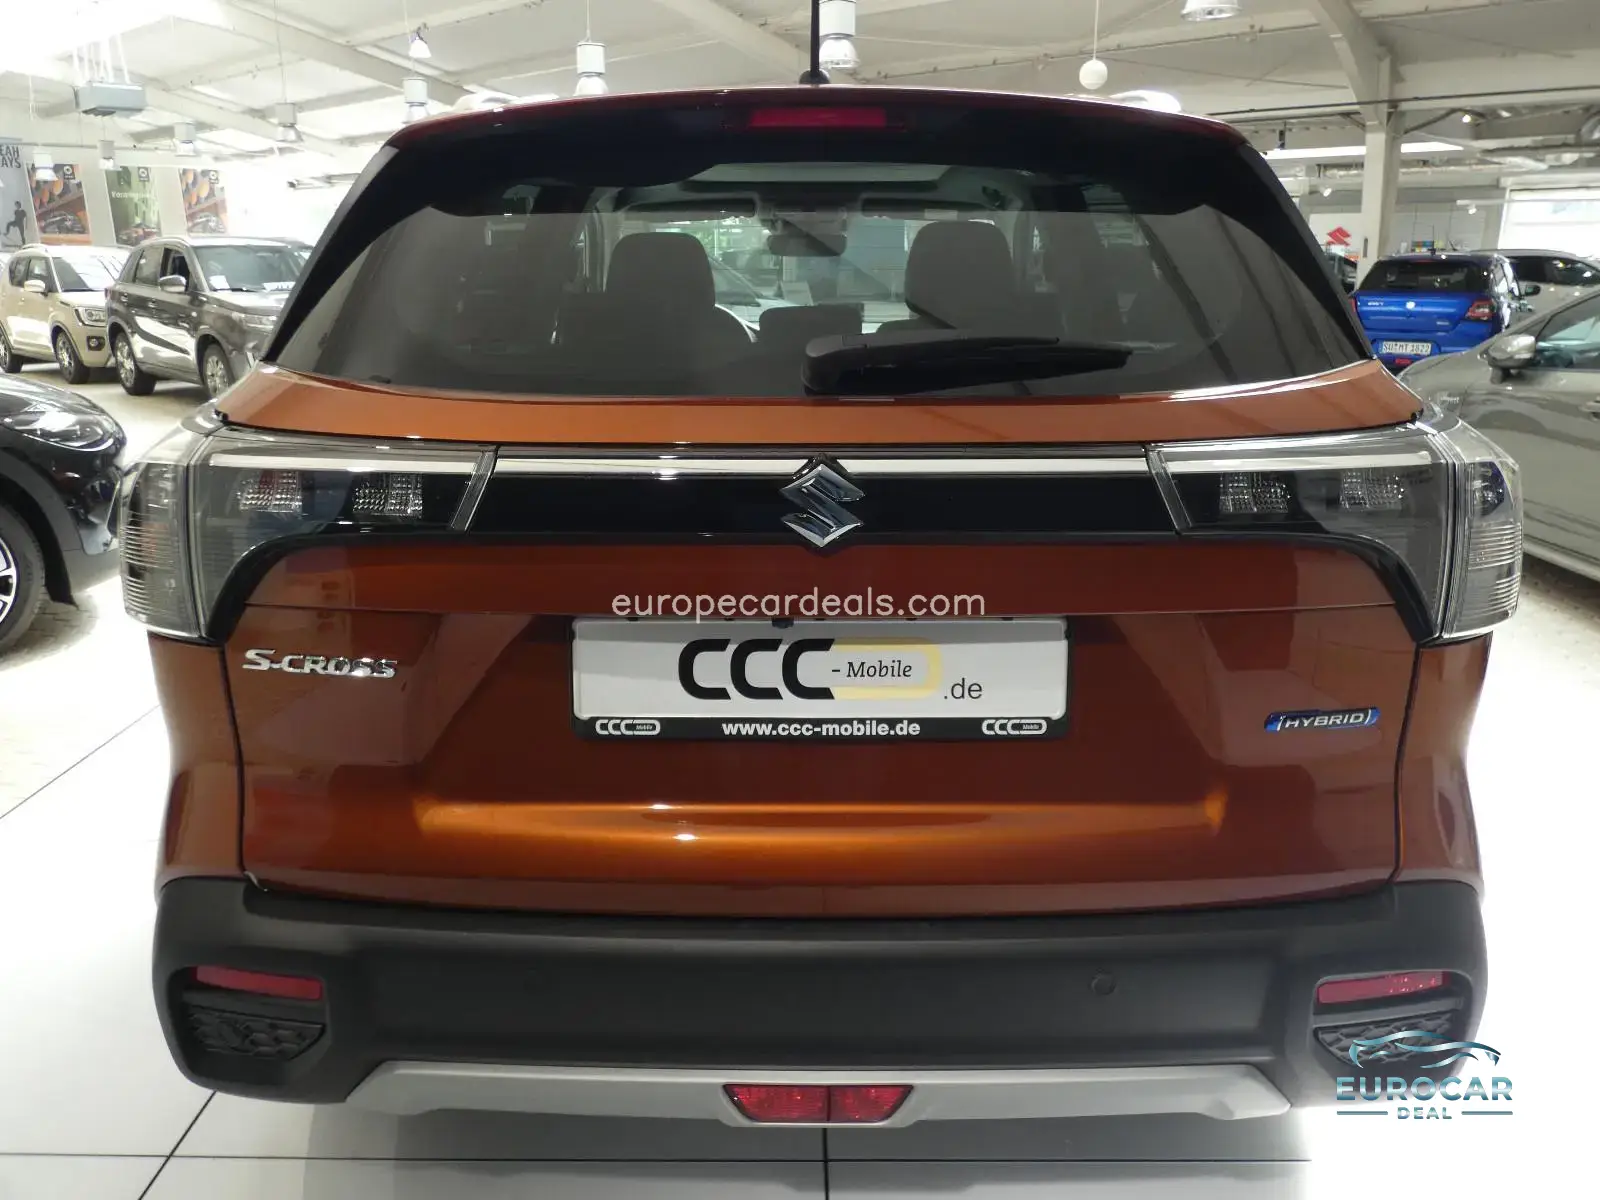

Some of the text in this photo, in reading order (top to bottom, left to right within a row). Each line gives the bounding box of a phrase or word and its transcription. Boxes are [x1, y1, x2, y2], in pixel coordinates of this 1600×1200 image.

[241, 648, 398, 678] S-CROSS
[677, 637, 836, 700] CCC
[846, 659, 913, 679] Mobile
[722, 718, 921, 737] www.ccc-mobile.de
[1284, 712, 1365, 728] HYBRID
